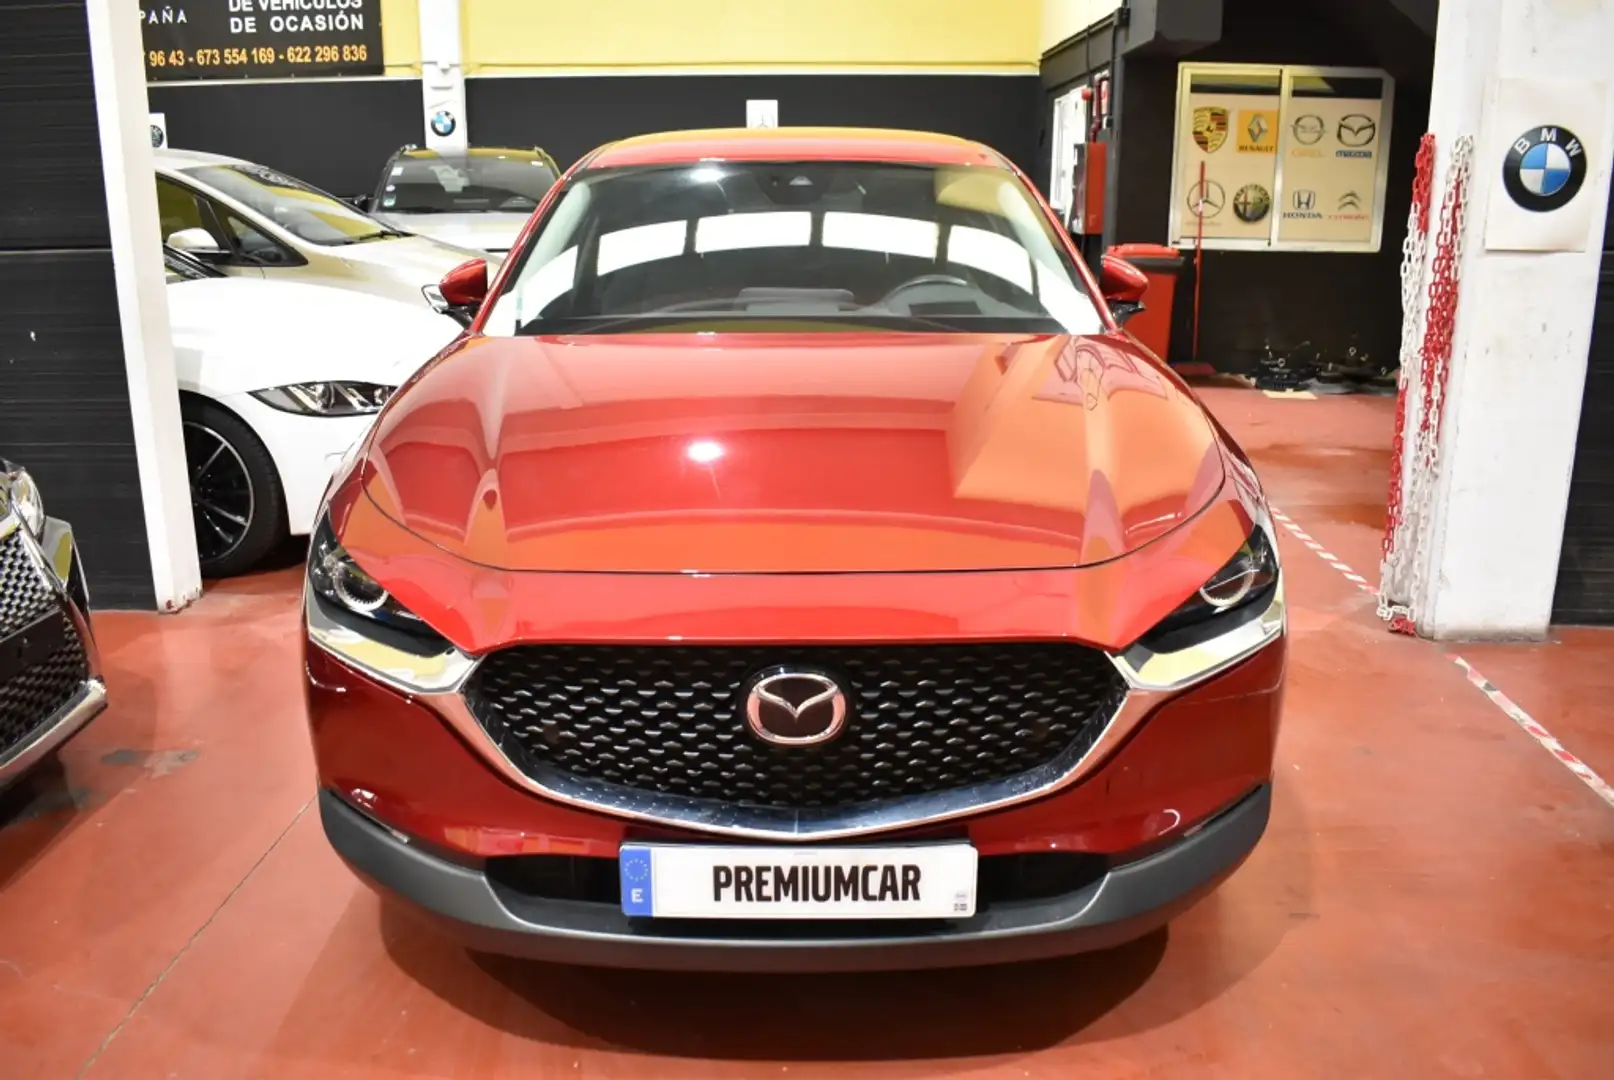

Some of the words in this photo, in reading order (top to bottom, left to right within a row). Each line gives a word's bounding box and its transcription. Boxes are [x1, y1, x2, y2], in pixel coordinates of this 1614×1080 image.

[228, 0, 254, 12] DE
[229, 16, 257, 34] DE
[269, 10, 364, 33] OCASIÓN
[149, 50, 166, 67] 96
[168, 49, 185, 66] 43
[196, 48, 221, 65] 673
[223, 47, 248, 65] 554
[251, 47, 275, 64] 169
[286, 45, 312, 63] 622
[314, 45, 340, 62] 296
[342, 44, 368, 61] 836
[1513, 127, 1582, 157] BMW
[712, 864, 921, 903] PREMIUMCAR
[631, 888, 643, 903] E
